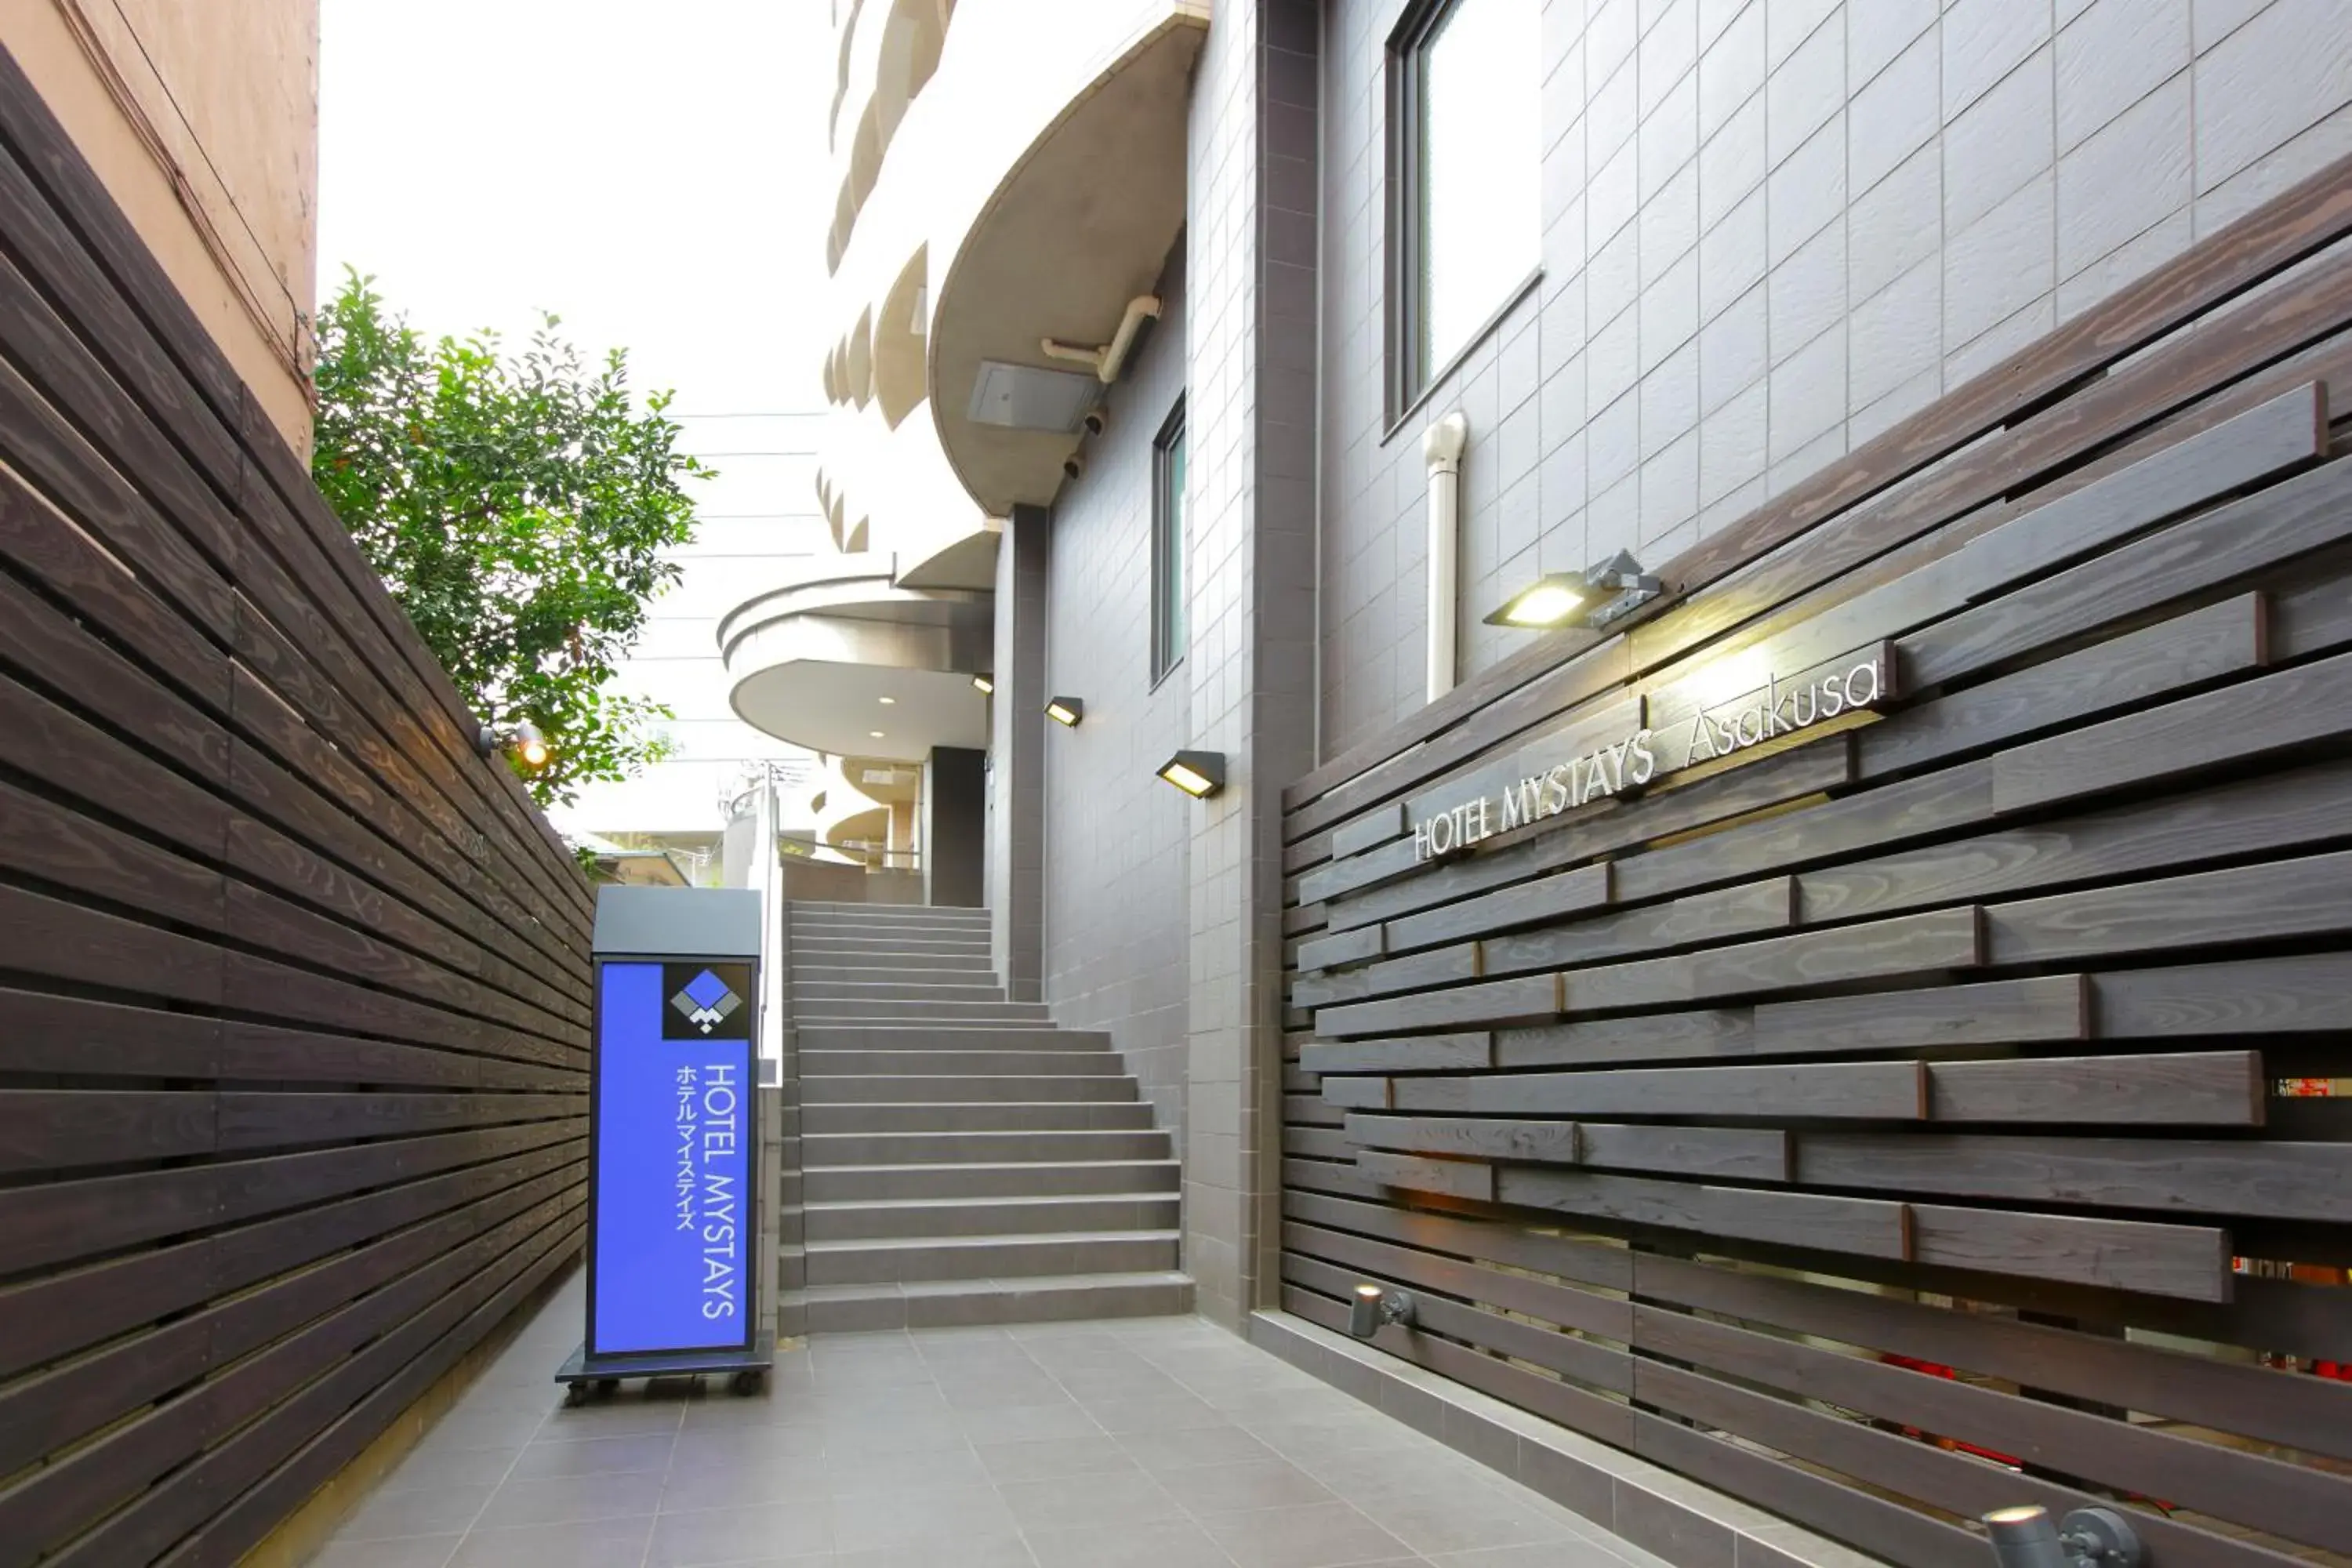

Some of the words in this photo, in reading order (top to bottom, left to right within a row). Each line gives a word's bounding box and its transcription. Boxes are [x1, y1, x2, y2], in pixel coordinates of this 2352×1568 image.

[1415, 796, 1492, 862] HOTEL
[1501, 728, 1654, 833] MYSTAYS
[1686, 659, 1879, 768] Asakusa
[676, 1065, 698, 1230] ホテルマイステイズ
[704, 1065, 736, 1163] HOTEL
[702, 1174, 735, 1320] MYSTAYS
